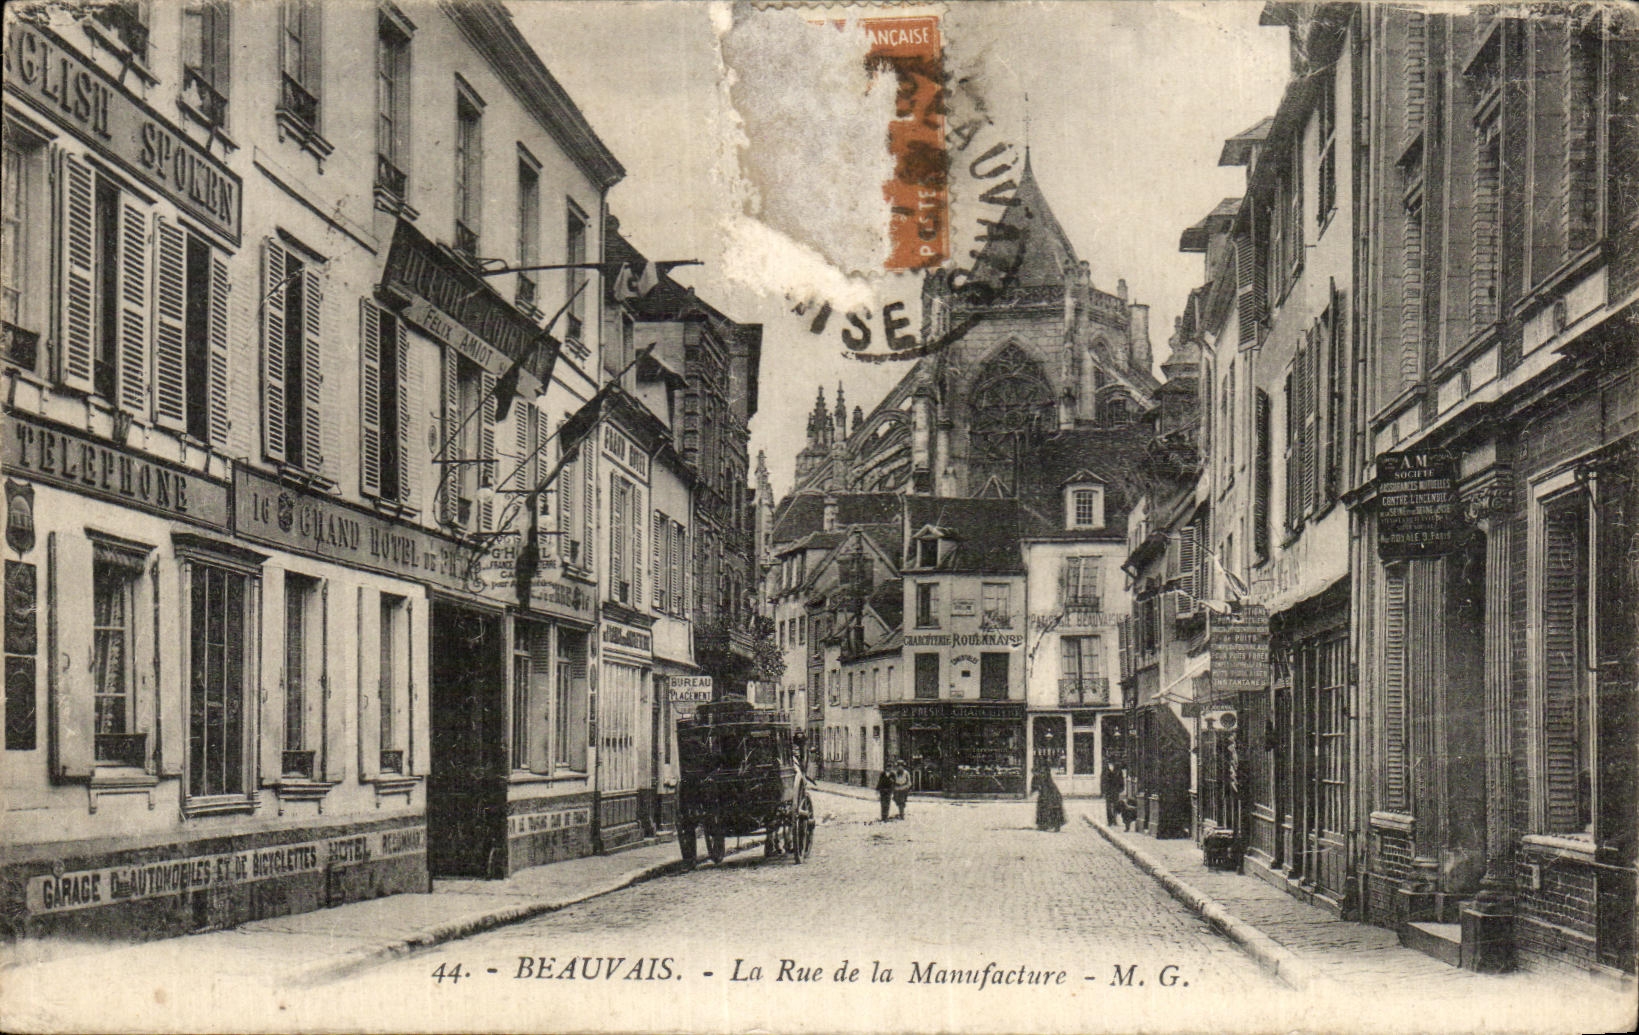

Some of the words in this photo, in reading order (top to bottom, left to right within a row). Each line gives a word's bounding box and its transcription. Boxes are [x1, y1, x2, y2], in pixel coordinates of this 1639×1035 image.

[866, 26, 929, 48] ANÇAISE
[6, 28, 114, 141] GLISH
[140, 121, 234, 226] SPOKEN
[458, 333, 494, 367] AMIOT
[16, 422, 189, 512] TELEPHONE
[300, 502, 359, 551] GRAND
[370, 527, 419, 567] HOTEL
[669, 690, 712, 701] PLACEMENT
[670, 677, 712, 687] BUREAU
[43, 873, 101, 909] GARAGE
[216, 858, 231, 882] ET
[235, 854, 248, 880] DE
[253, 845, 317, 878] BICYCLETTES
